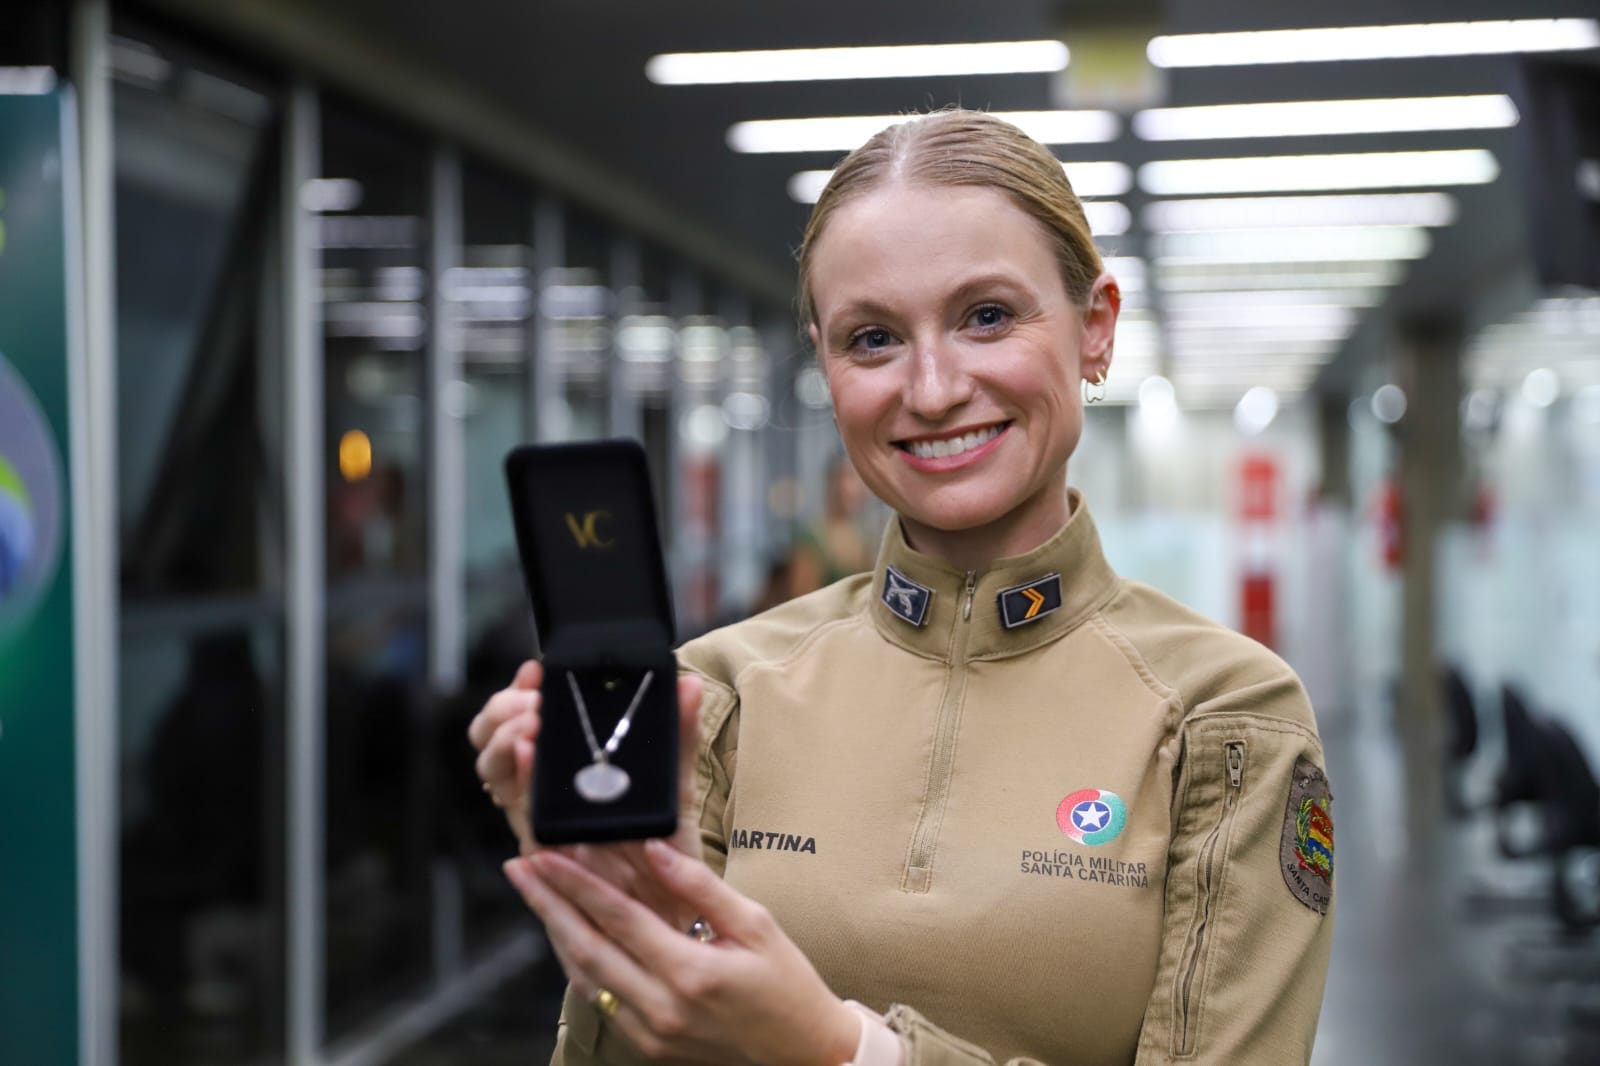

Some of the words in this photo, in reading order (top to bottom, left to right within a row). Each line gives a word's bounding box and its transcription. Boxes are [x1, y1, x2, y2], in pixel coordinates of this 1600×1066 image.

[1020, 862, 1073, 878] SANTA
[1078, 869, 1148, 888] CATARINA
[1021, 850, 1084, 867] POLÍCIA
[1089, 857, 1147, 874] MILITAR
[1287, 863, 1310, 896] SANTA
